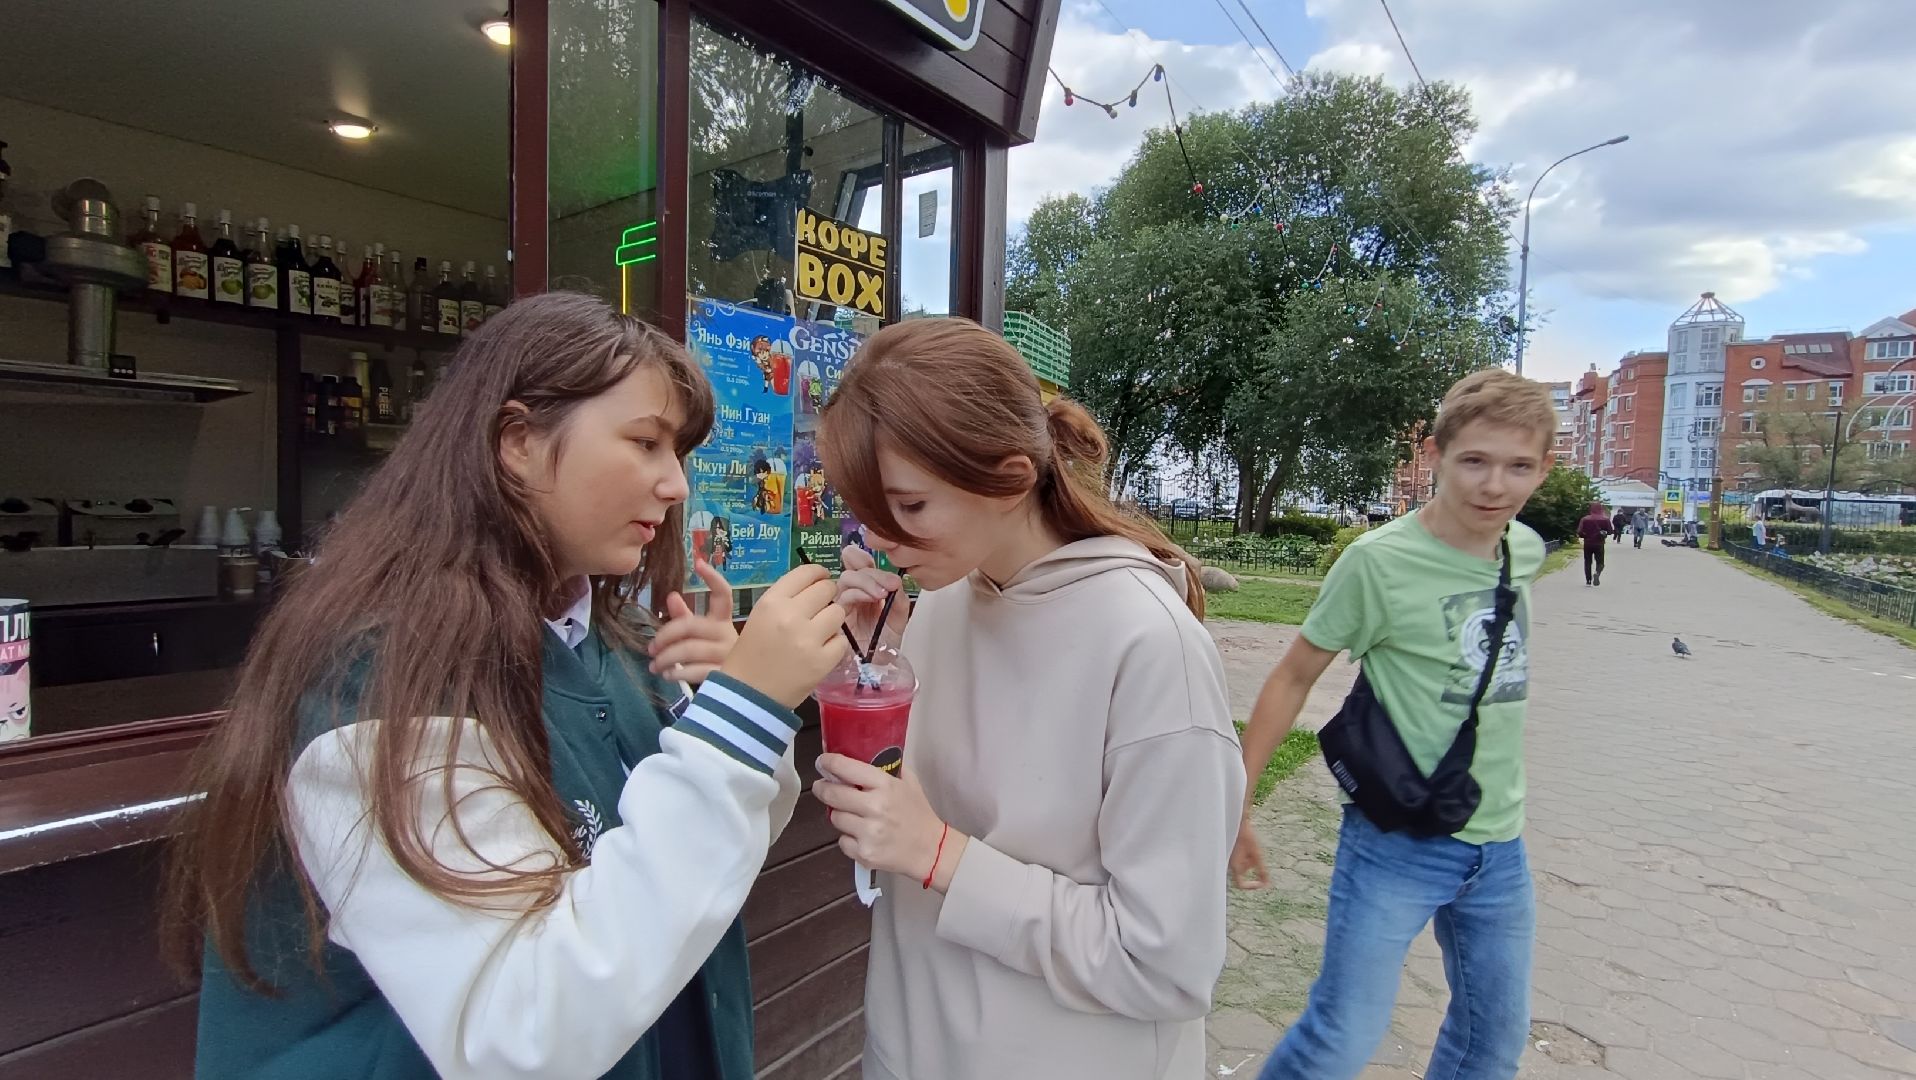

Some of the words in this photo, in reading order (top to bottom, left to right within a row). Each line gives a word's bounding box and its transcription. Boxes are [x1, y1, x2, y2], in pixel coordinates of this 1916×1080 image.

[797, 208, 887, 268] КОФЕ
[798, 253, 883, 314] BOX
[698, 328, 722, 346] Янь
[726, 332, 750, 351] Фэй
[721, 404, 742, 421] Нин
[745, 407, 770, 425] Гуан
[693, 458, 727, 475] Чжун
[730, 460, 747, 475] Ли
[731, 523, 755, 538] Бей
[758, 523, 781, 540] Доу
[800, 531, 842, 546] Райдэн
